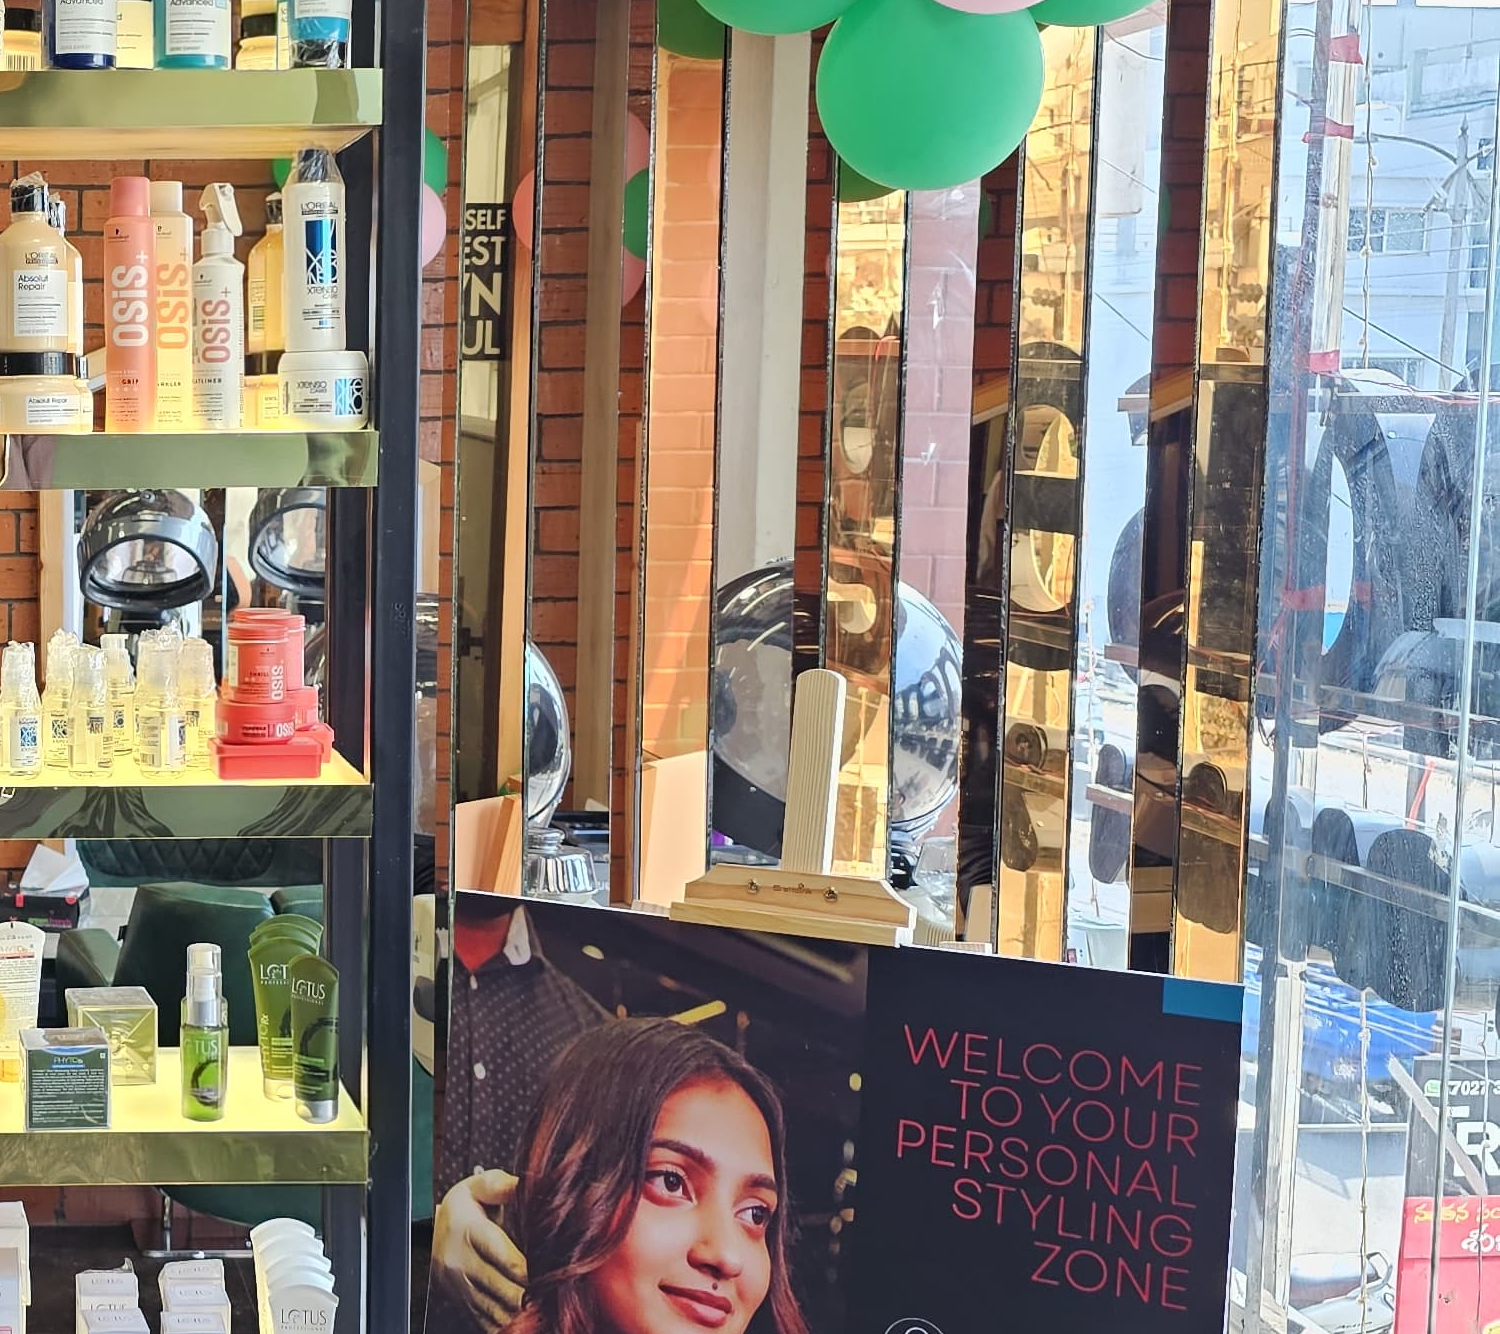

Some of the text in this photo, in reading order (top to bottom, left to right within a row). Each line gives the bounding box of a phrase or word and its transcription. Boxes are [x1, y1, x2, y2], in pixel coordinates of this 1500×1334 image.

[18, 275, 49, 283] Absolut
[18, 283, 46, 292] Repair
[260, 964, 288, 980] LOT
[291, 978, 326, 1000] LOTUS
[904, 1023, 1203, 1107] WELCOME
[950, 1079, 1200, 1157] TO YOUR
[897, 1119, 1196, 1209] PERSONAL
[952, 1178, 1193, 1258] STYLING
[1030, 1241, 1188, 1311] ZONE
[281, 1309, 327, 1325] LOTUS
